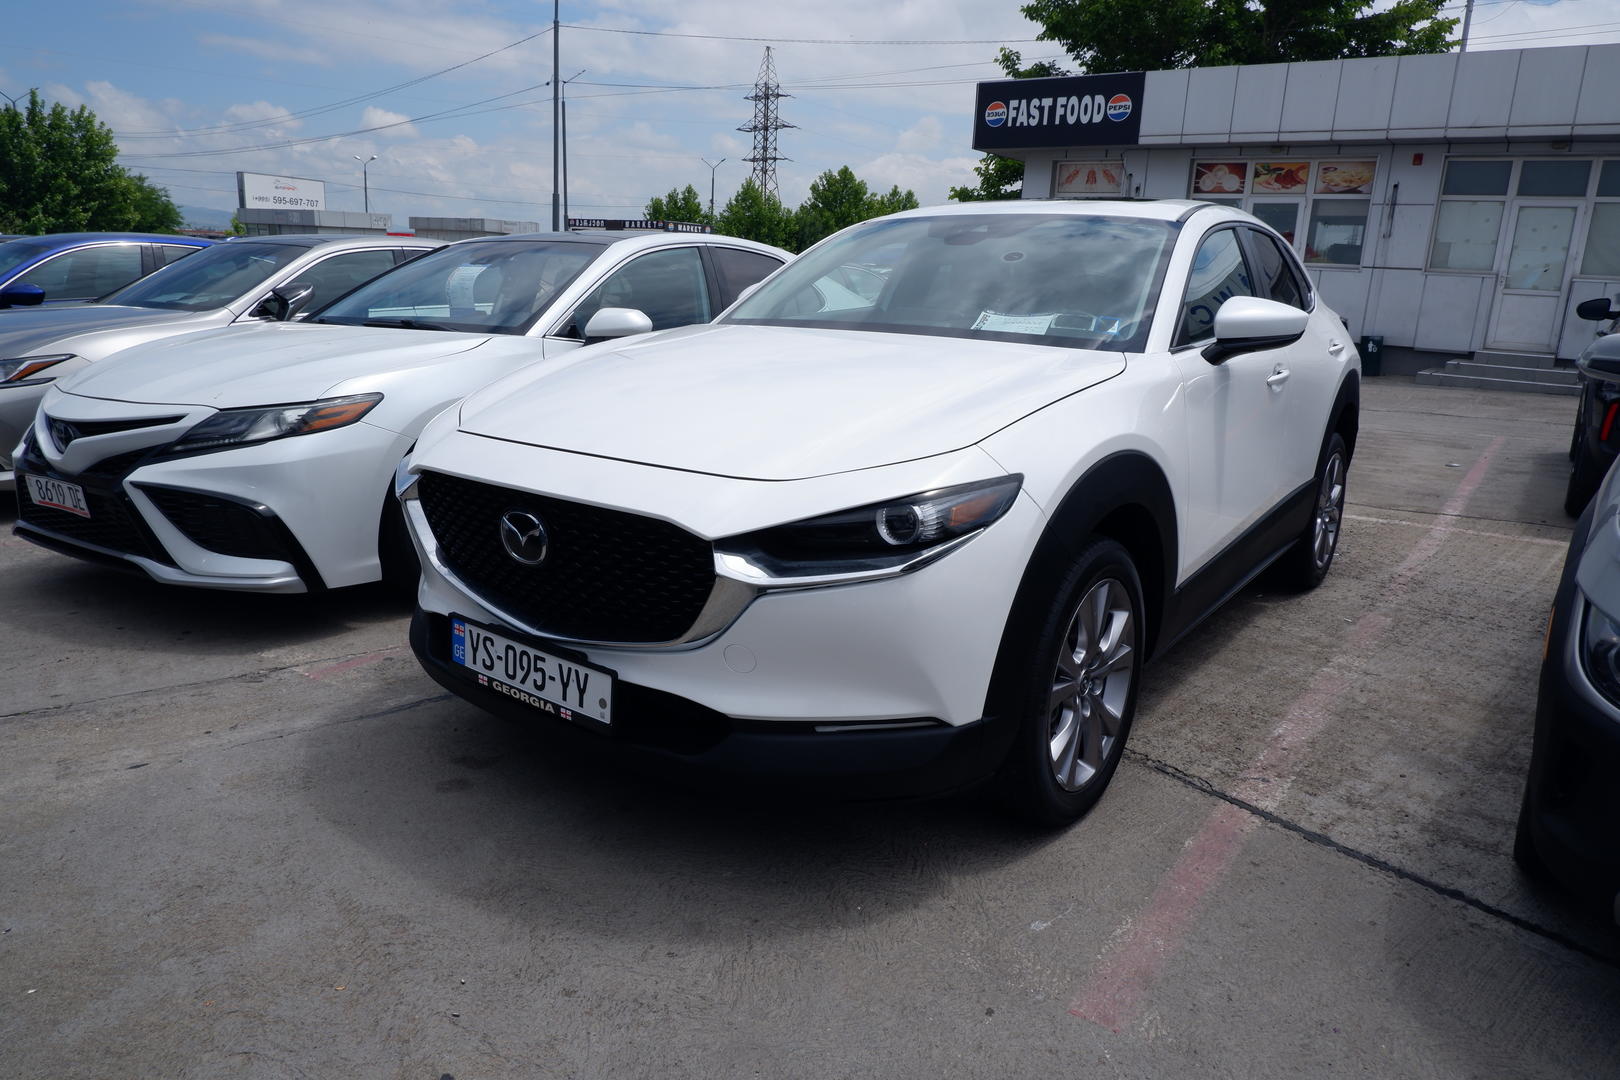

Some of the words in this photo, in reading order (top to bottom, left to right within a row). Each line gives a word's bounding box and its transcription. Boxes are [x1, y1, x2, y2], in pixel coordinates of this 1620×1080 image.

[1007, 97, 1054, 127] FAST
[1055, 94, 1106, 126] FOOD
[1108, 103, 1131, 112] PEPSI
[272, 195, 320, 208] 595-697-707
[624, 220, 658, 229] MARKET
[677, 224, 702, 233] MARKET
[35, 479, 66, 505] 8619
[68, 486, 86, 511] DE
[454, 643, 465, 660] GE
[468, 628, 589, 709] YS-095-YY
[492, 681, 556, 715] GEORGIA
